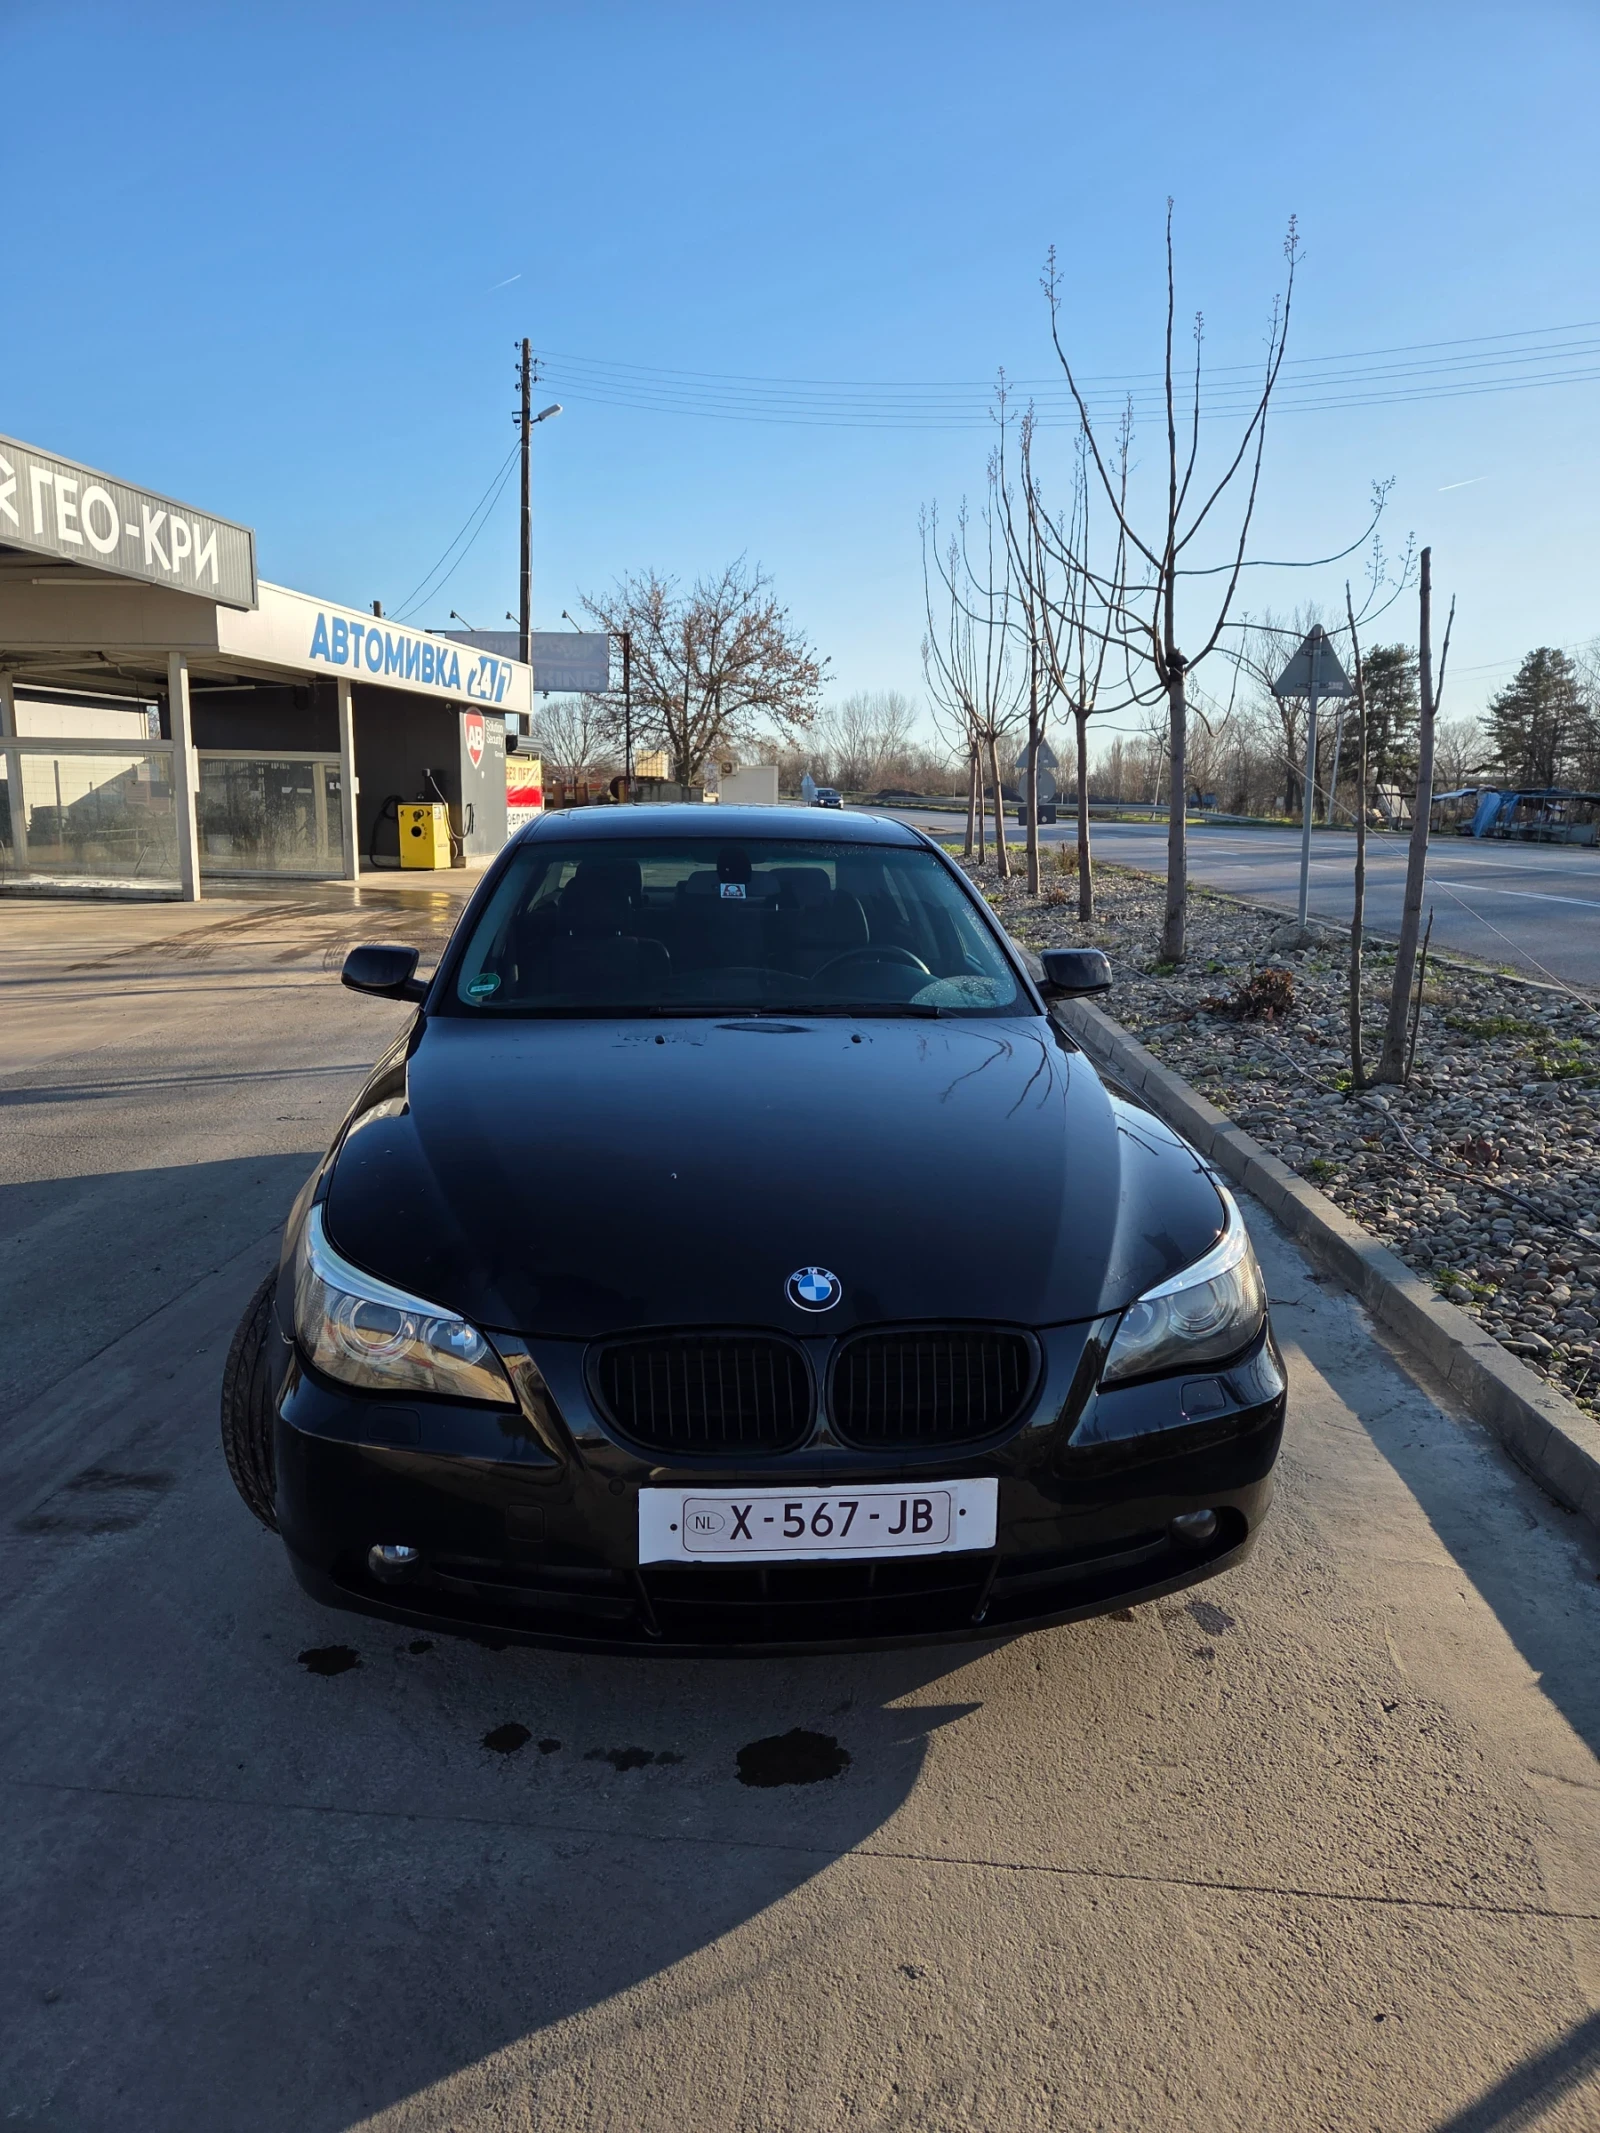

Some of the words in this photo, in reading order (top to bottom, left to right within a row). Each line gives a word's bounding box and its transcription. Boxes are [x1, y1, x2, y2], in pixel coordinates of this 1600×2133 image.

[29, 464, 219, 585] ГЕО-КРИ
[309, 612, 461, 690] АВТОМИВКА
[467, 656, 512, 702] 24/7
[534, 670, 600, 688] KING
[486, 732, 504, 748] Security
[792, 1267, 837, 1281] BMW
[695, 1516, 716, 1529] NL
[730, 1498, 934, 1540] X-567-JB
